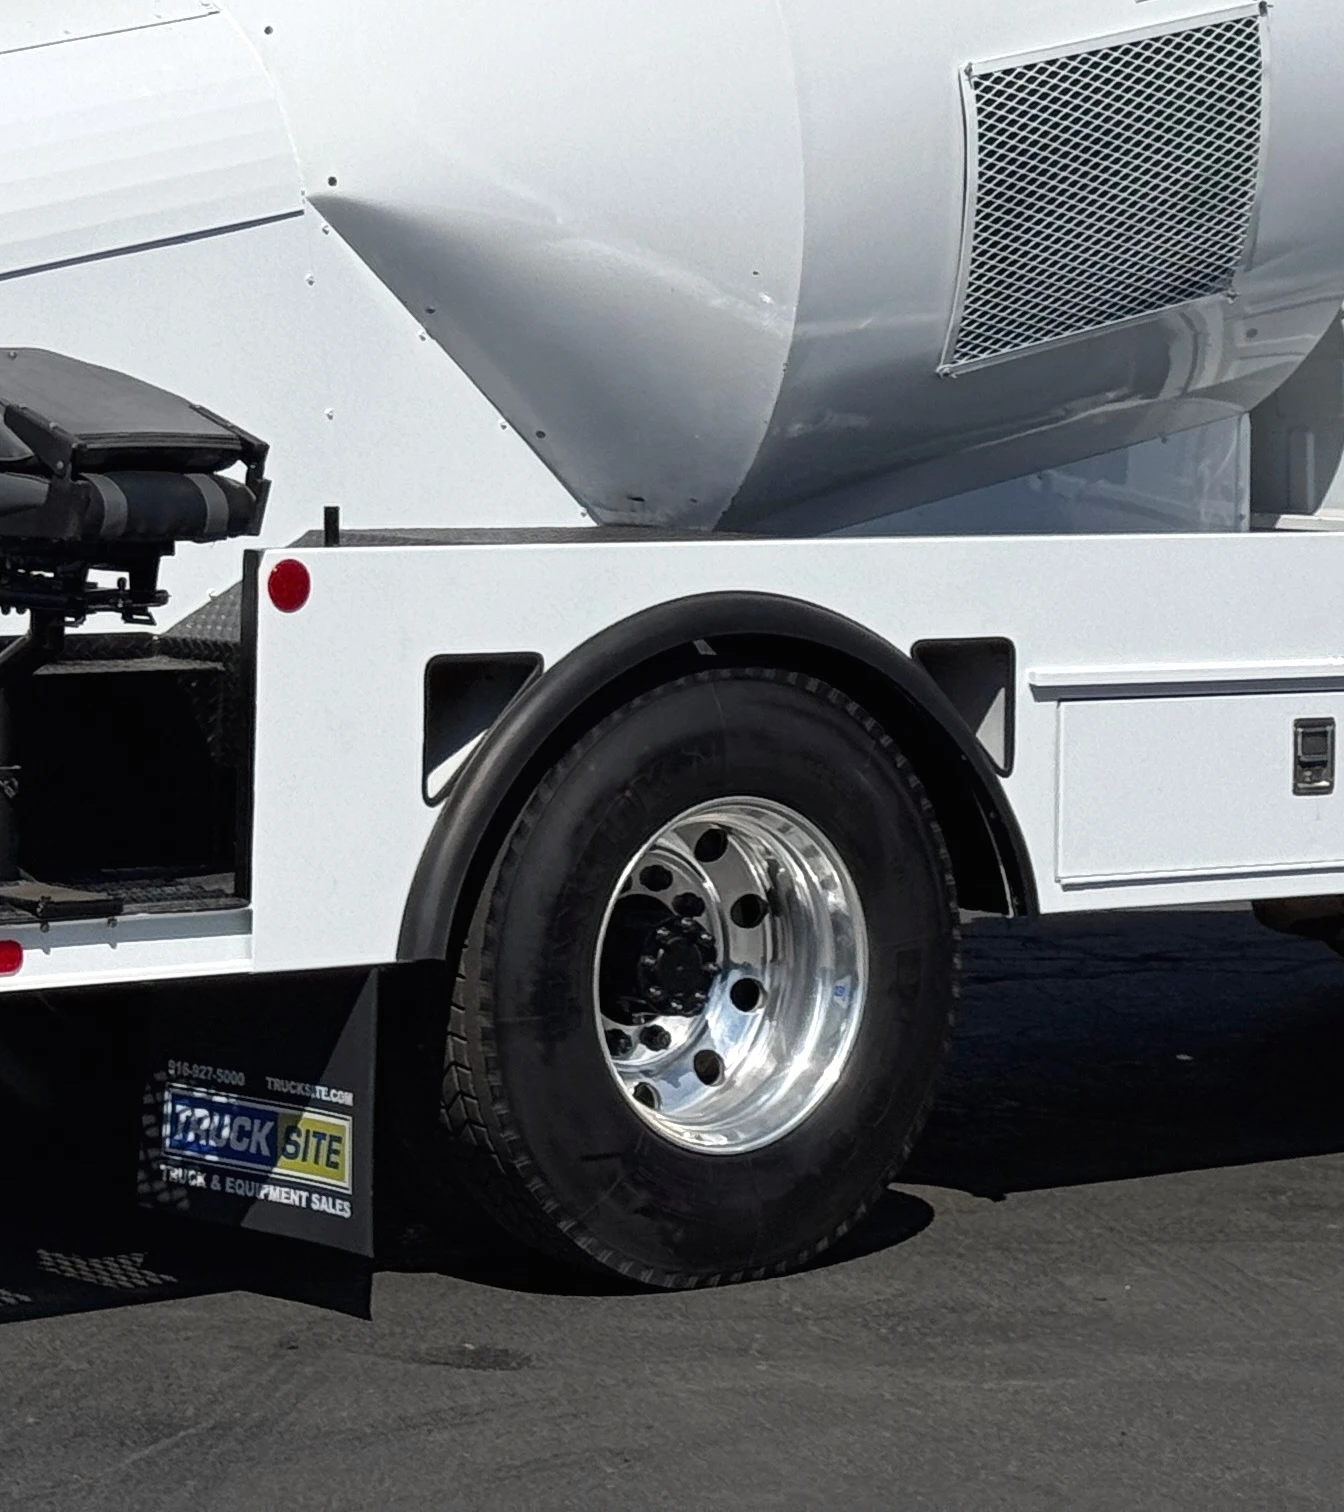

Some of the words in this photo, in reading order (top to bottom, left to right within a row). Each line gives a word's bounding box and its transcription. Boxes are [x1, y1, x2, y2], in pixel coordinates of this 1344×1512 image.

[265, 1076, 354, 1107] TRUCKSITE.COM
[172, 1103, 276, 1158] TRUCK
[281, 1125, 344, 1170] SITE
[159, 1163, 207, 1190] TRUCK
[210, 1174, 223, 1191] &
[224, 1176, 310, 1209] EQUIPMENT
[310, 1193, 352, 1219] SALES
